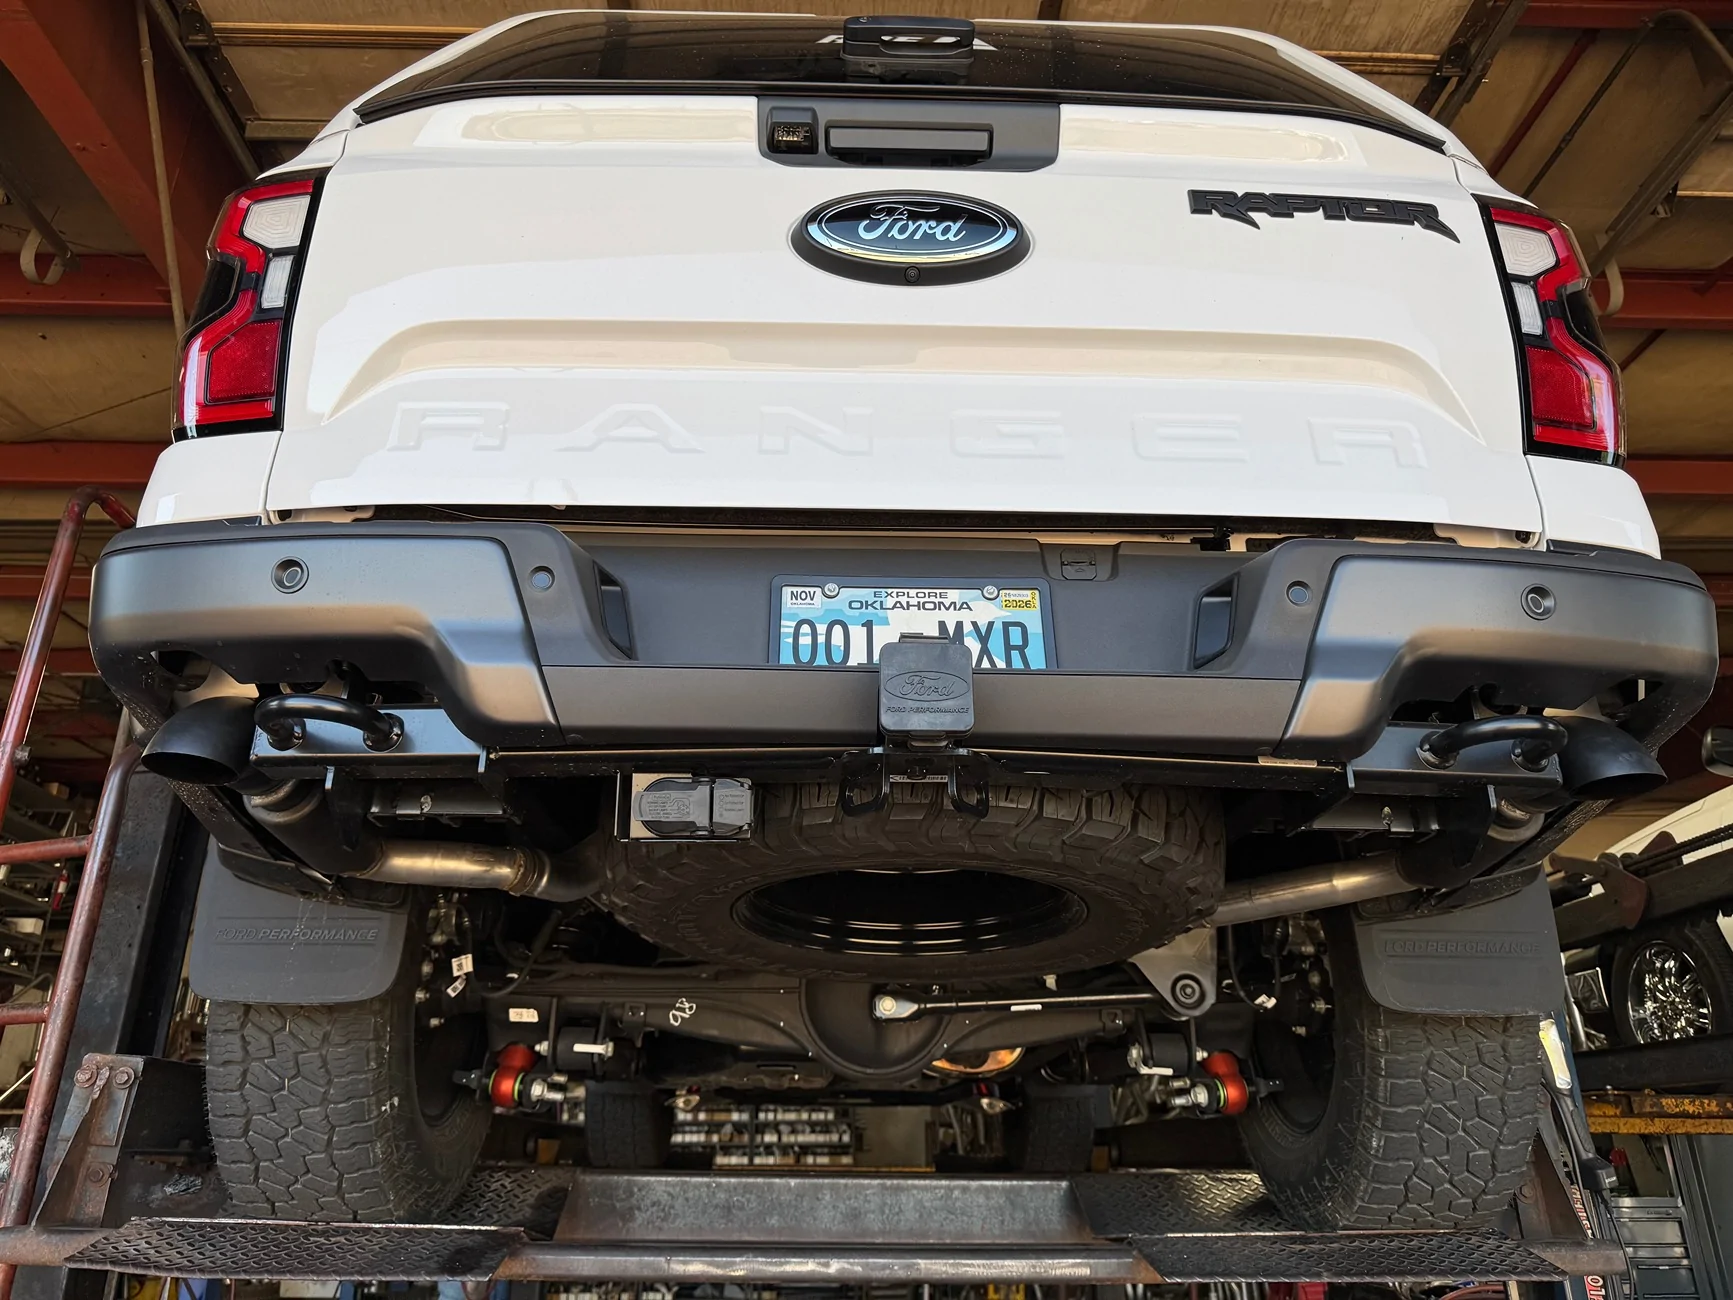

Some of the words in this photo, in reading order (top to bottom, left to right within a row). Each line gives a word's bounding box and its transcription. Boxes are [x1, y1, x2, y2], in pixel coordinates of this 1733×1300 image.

[857, 204, 968, 242] Ford
[1187, 189, 1460, 244] RAPTOR
[387, 401, 1430, 470] RANGER
[790, 590, 817, 601] NOV
[873, 590, 949, 599] EXPLORE
[848, 600, 974, 613] OKLAHOMA
[1004, 599, 1032, 609] 2026
[792, 618, 880, 666] 001
[899, 674, 956, 697] Ford
[907, 706, 970, 714] PERFORMANCE
[214, 928, 256, 941] FORD
[257, 928, 379, 941] PERFORMANCE
[1384, 939, 1425, 954] FORD
[1426, 940, 1541, 956] PERFORMANCE
